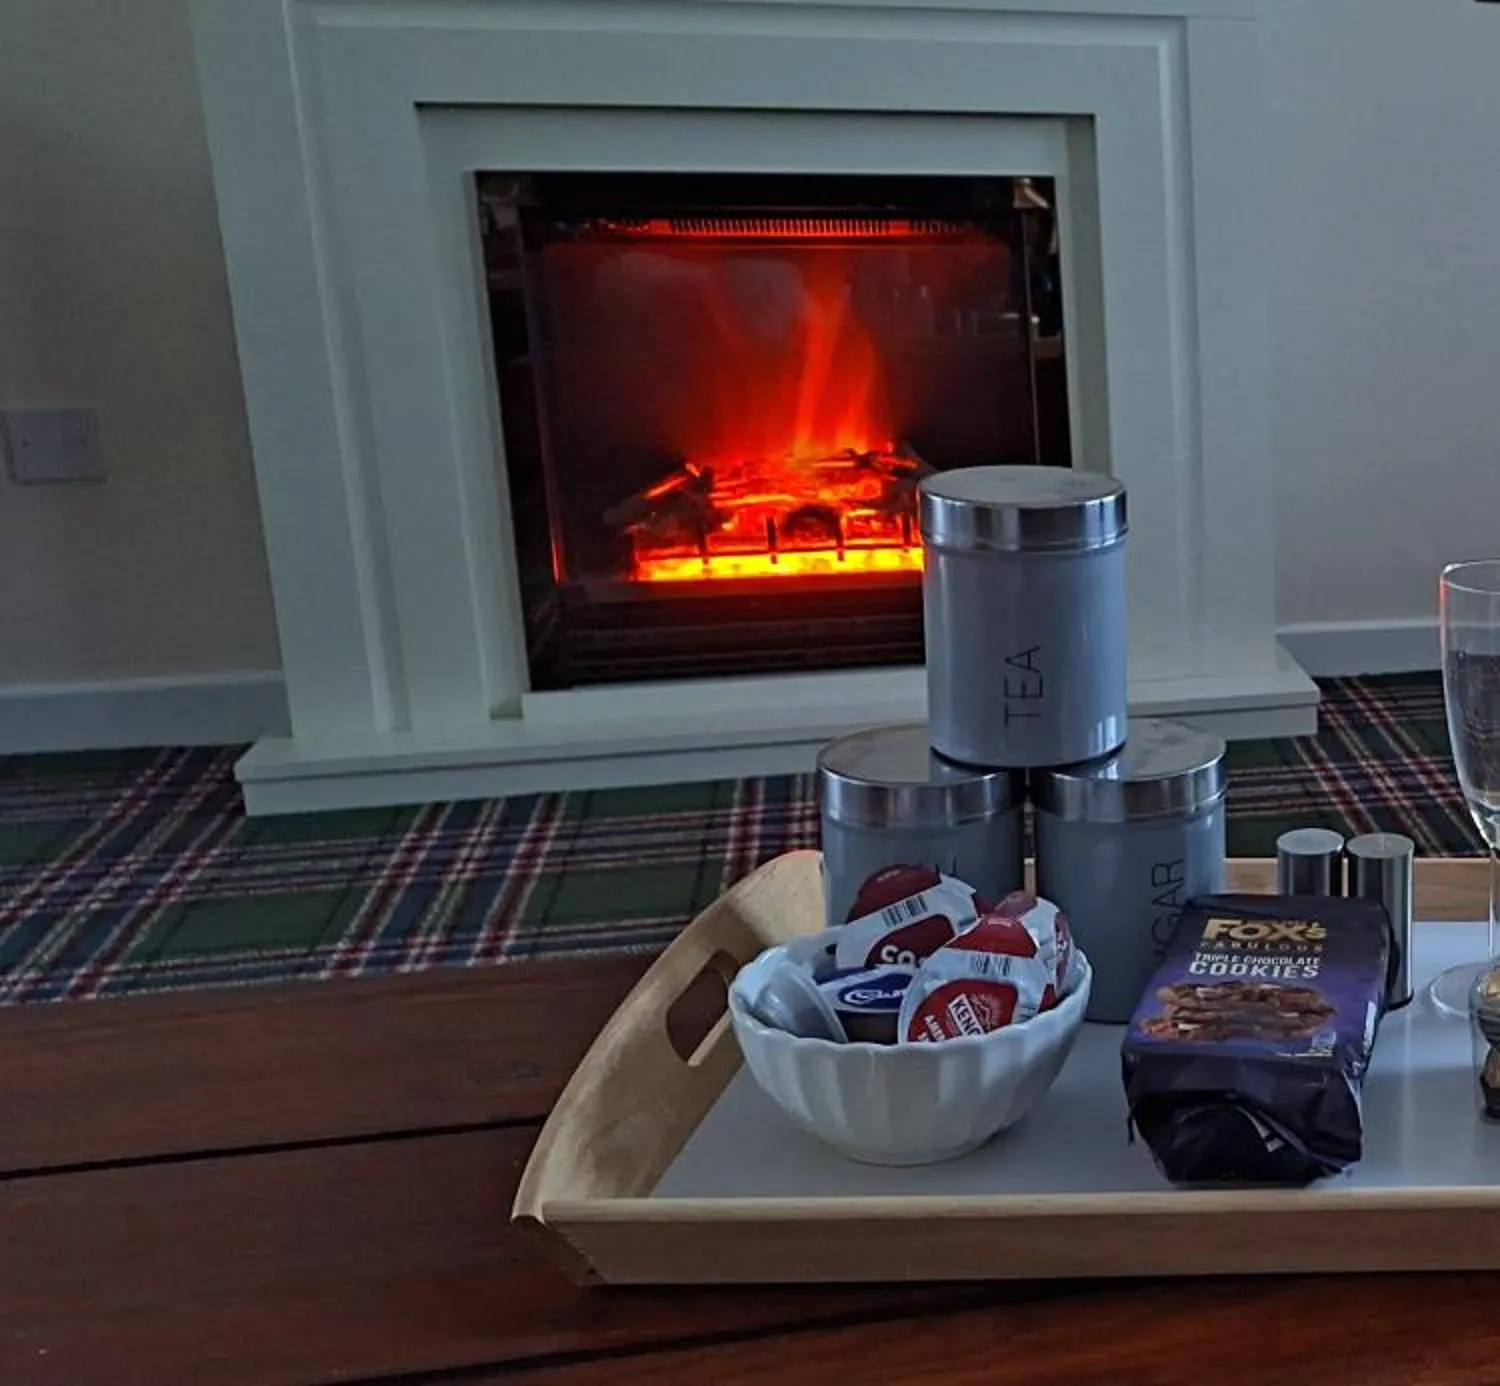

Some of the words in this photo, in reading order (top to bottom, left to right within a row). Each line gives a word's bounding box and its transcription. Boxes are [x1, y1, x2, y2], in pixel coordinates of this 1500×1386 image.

[1004, 645, 1043, 726] TEA
[1150, 859, 1184, 967] GAR
[1189, 960, 1320, 979] COOKIES
[1195, 952, 1241, 964] TRIPLE
[1243, 954, 1320, 966] CHOCOLATE
[951, 1000, 982, 1036] KENC
